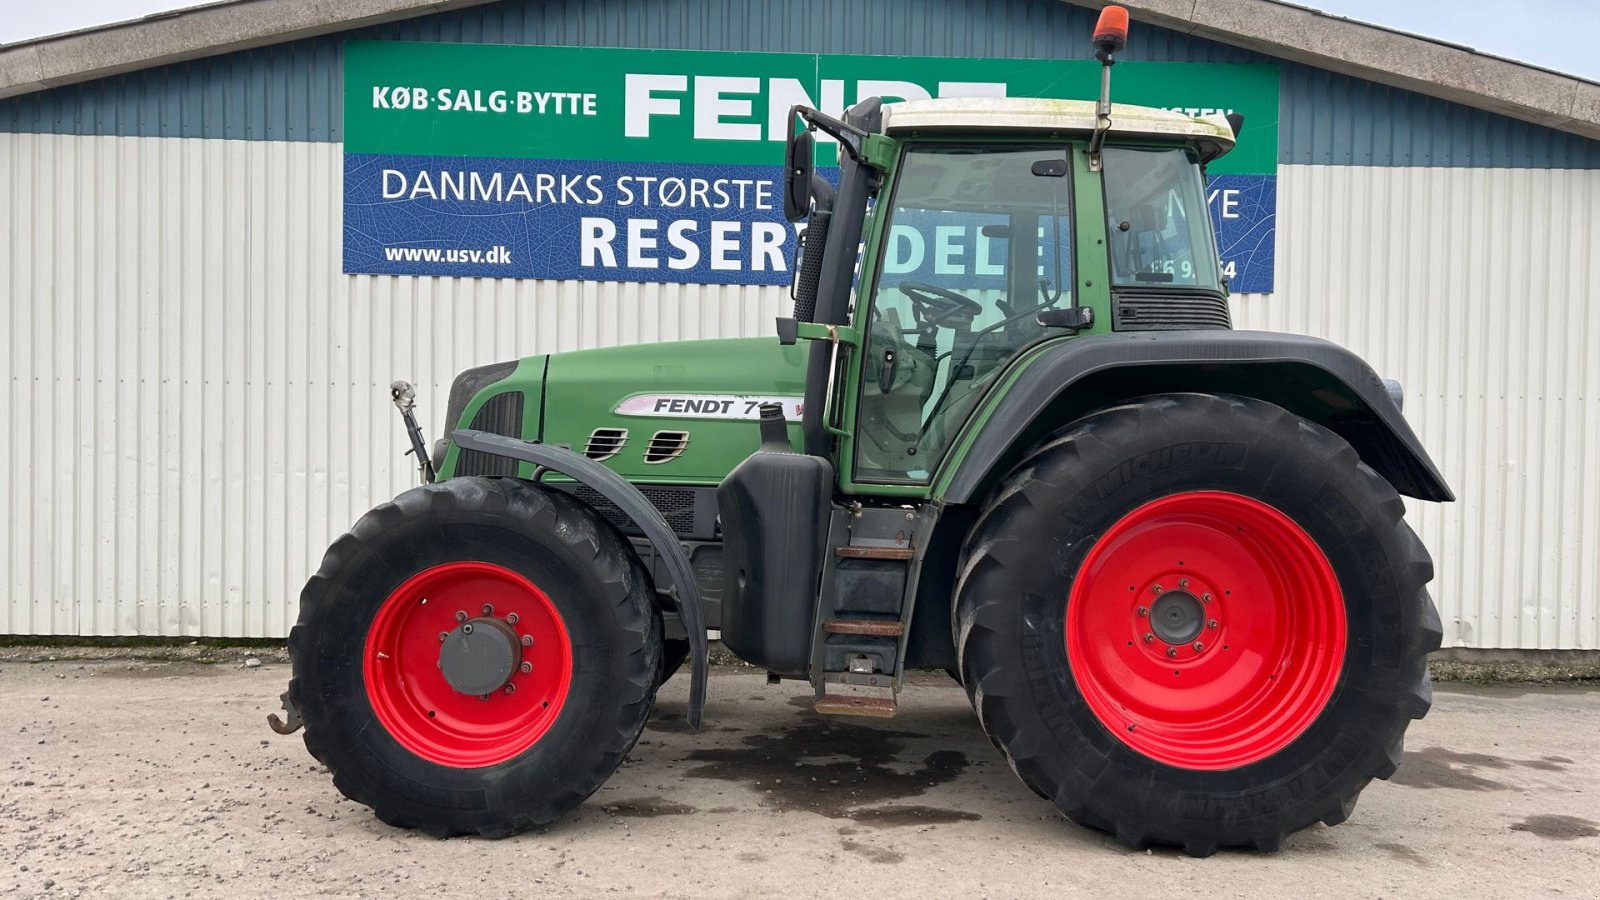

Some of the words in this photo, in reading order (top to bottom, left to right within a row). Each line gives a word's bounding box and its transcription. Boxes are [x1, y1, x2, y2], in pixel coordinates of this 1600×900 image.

[624, 73, 1007, 143] FEN
[382, 169, 603, 206] DANMARKS
[617, 175, 773, 210] STØRSTE
[385, 246, 511, 264] www.usv.dk
[653, 398, 735, 415] FENDT
[1094, 443, 1246, 500] MICHELIN
